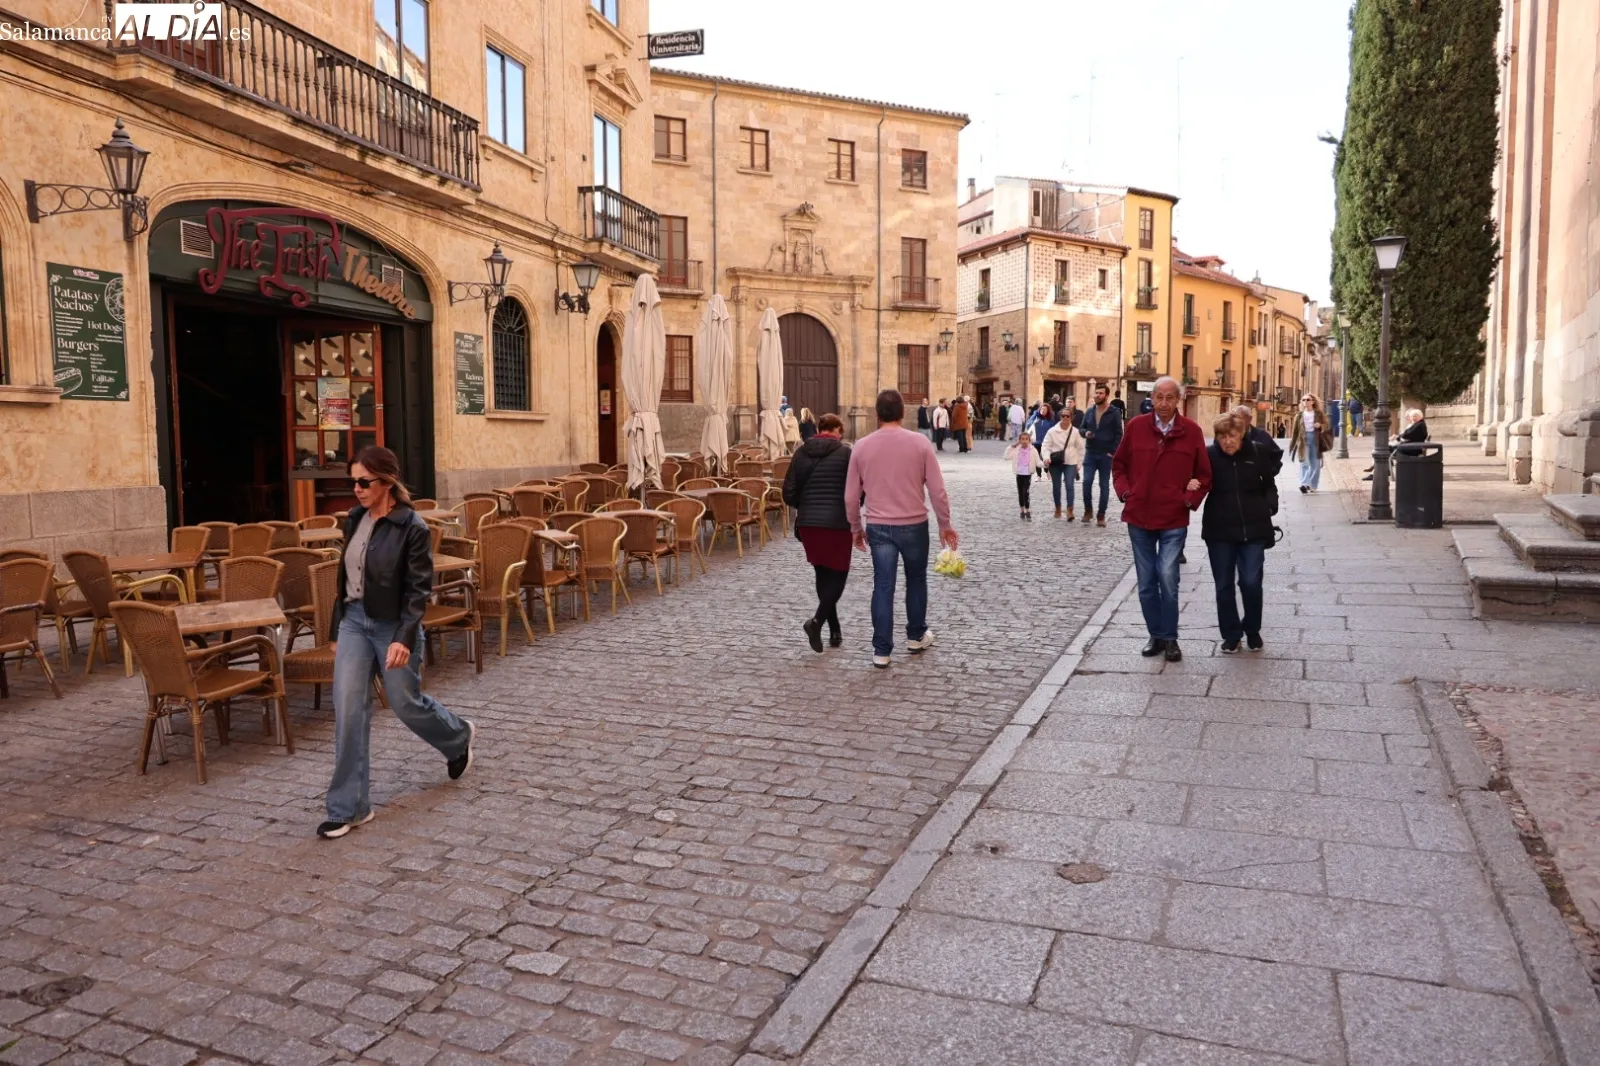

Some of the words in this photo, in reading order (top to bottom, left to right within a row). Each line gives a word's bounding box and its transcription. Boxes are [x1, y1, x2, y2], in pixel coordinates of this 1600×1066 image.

[656, 34, 696, 45] Residencia
[652, 42, 698, 53] Universitaria
[257, 223, 332, 308] Irish
[343, 245, 417, 319] Theatre
[54, 285, 93, 300] Patatas
[94, 292, 101, 304] y
[54, 298, 94, 312] Nachos
[87, 320, 102, 332] Hot
[103, 322, 122, 335] Dogs
[57, 338, 99, 353] Burgers
[91, 373, 116, 384] Fajitas
